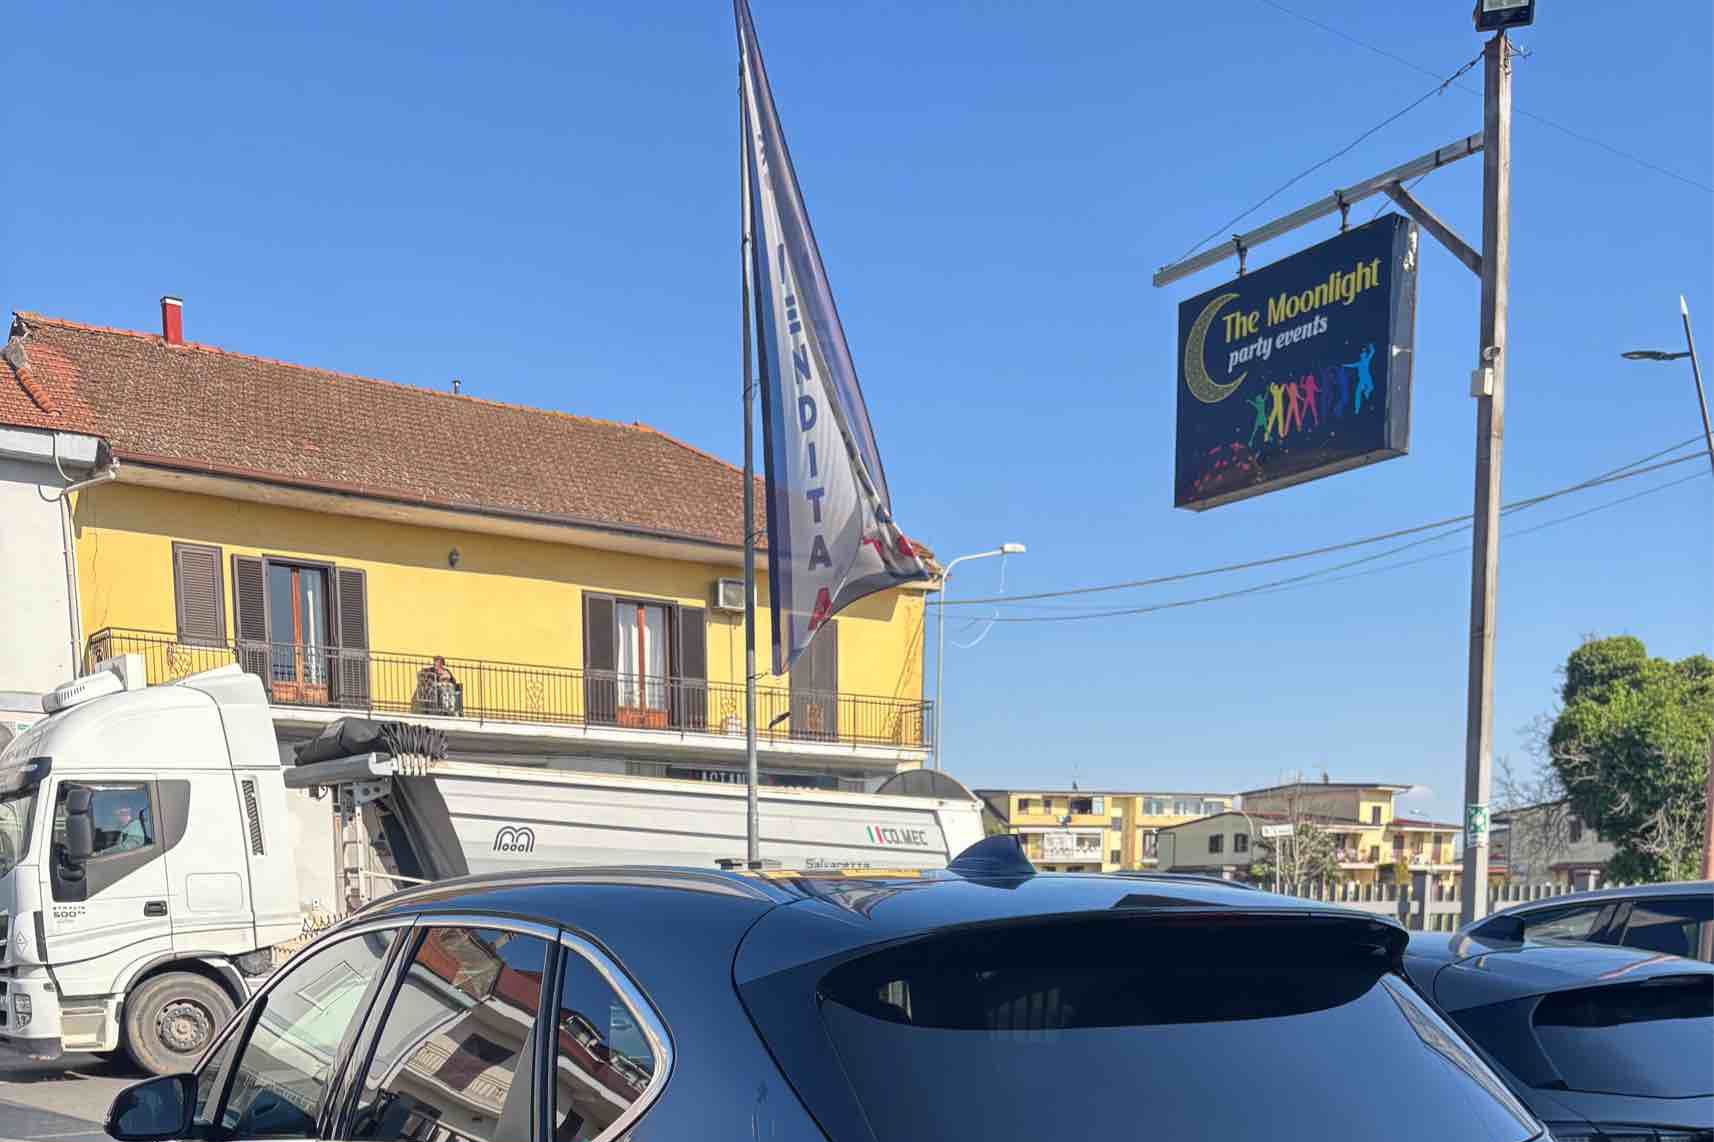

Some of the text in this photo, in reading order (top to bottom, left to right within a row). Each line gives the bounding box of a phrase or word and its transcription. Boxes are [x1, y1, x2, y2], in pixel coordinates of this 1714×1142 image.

[1222, 257, 1382, 344] The Moonlight
[1228, 314, 1328, 373] party events
